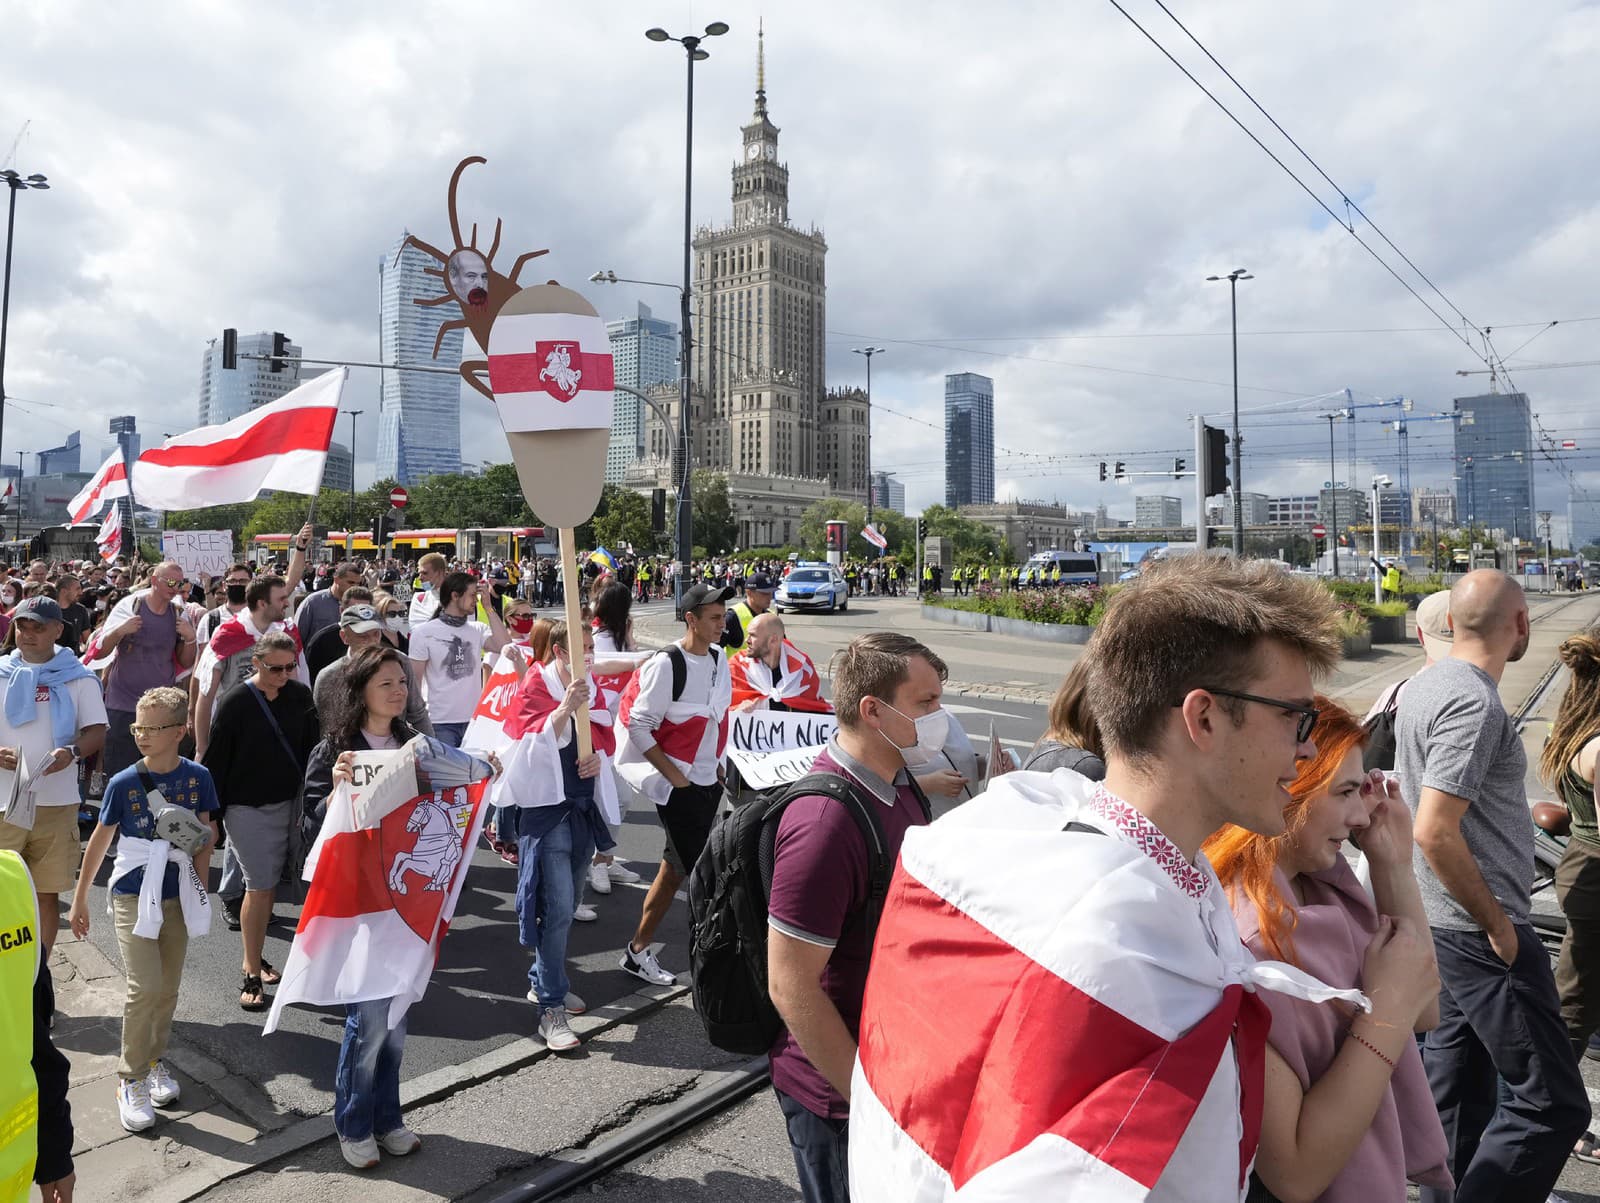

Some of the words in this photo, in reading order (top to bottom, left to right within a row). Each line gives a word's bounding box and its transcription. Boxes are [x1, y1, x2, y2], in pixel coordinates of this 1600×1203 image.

[175, 533, 222, 552] FREE
[733, 716, 785, 751] NAM
[796, 718, 829, 748] NIE
[0, 926, 33, 952] CJA
